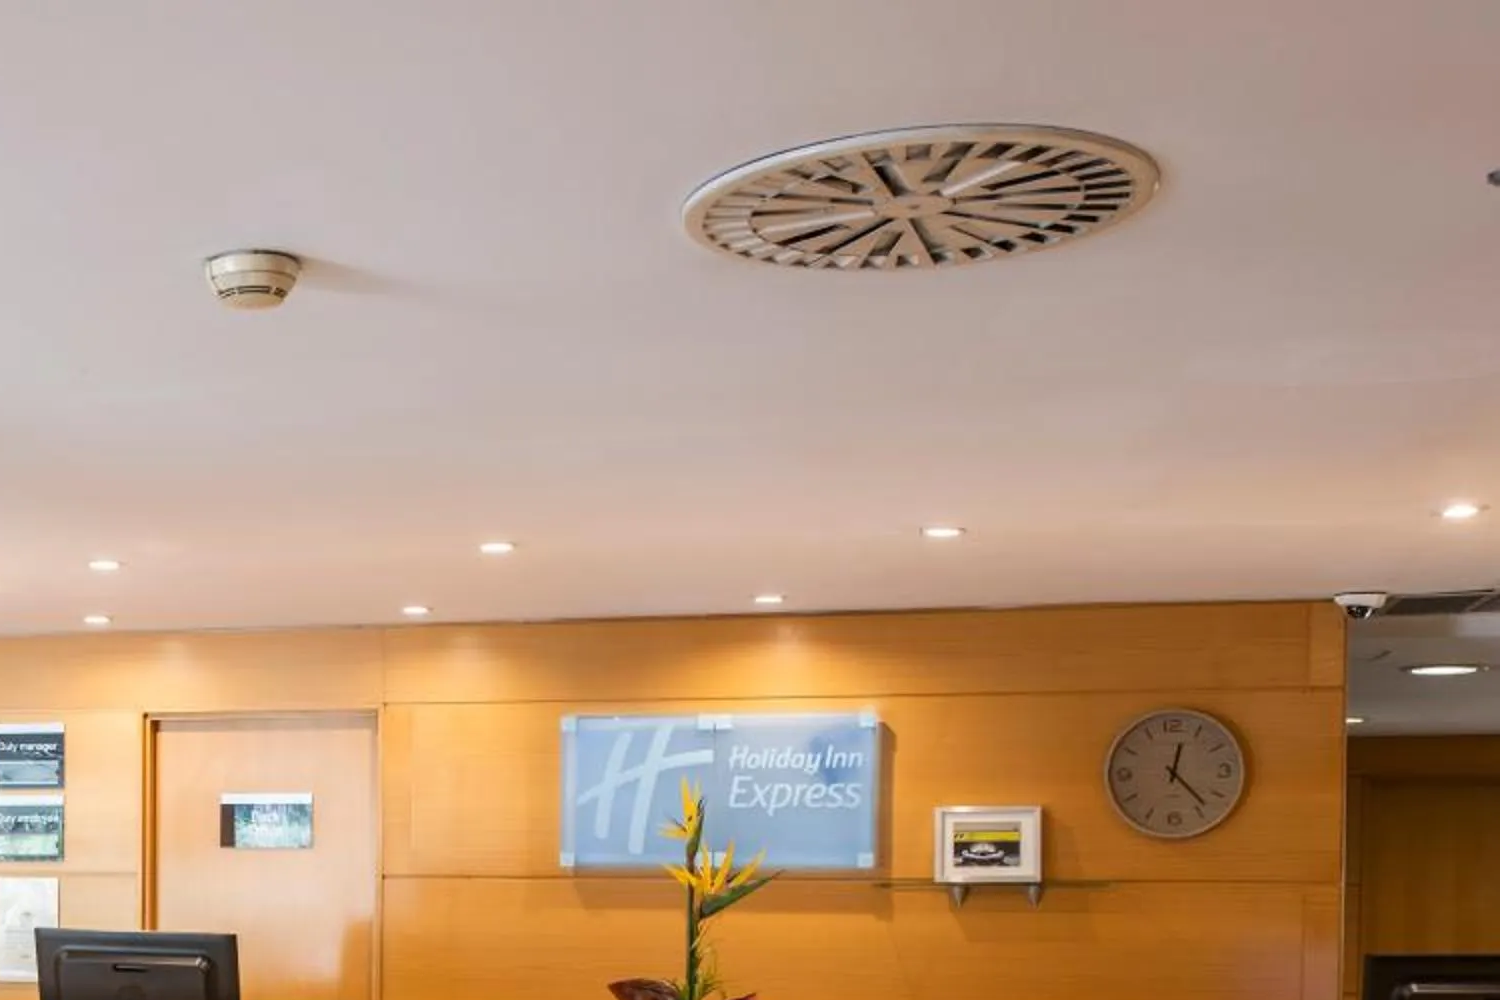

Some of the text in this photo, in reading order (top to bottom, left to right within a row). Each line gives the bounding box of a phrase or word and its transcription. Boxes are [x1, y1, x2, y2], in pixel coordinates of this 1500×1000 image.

[1163, 719, 1188, 733] 12
[729, 744, 863, 774] Holiday Inn
[1116, 767, 1133, 782] 9
[1217, 761, 1232, 779] 3
[729, 775, 862, 817] Express
[1166, 810, 1183, 826] 6
